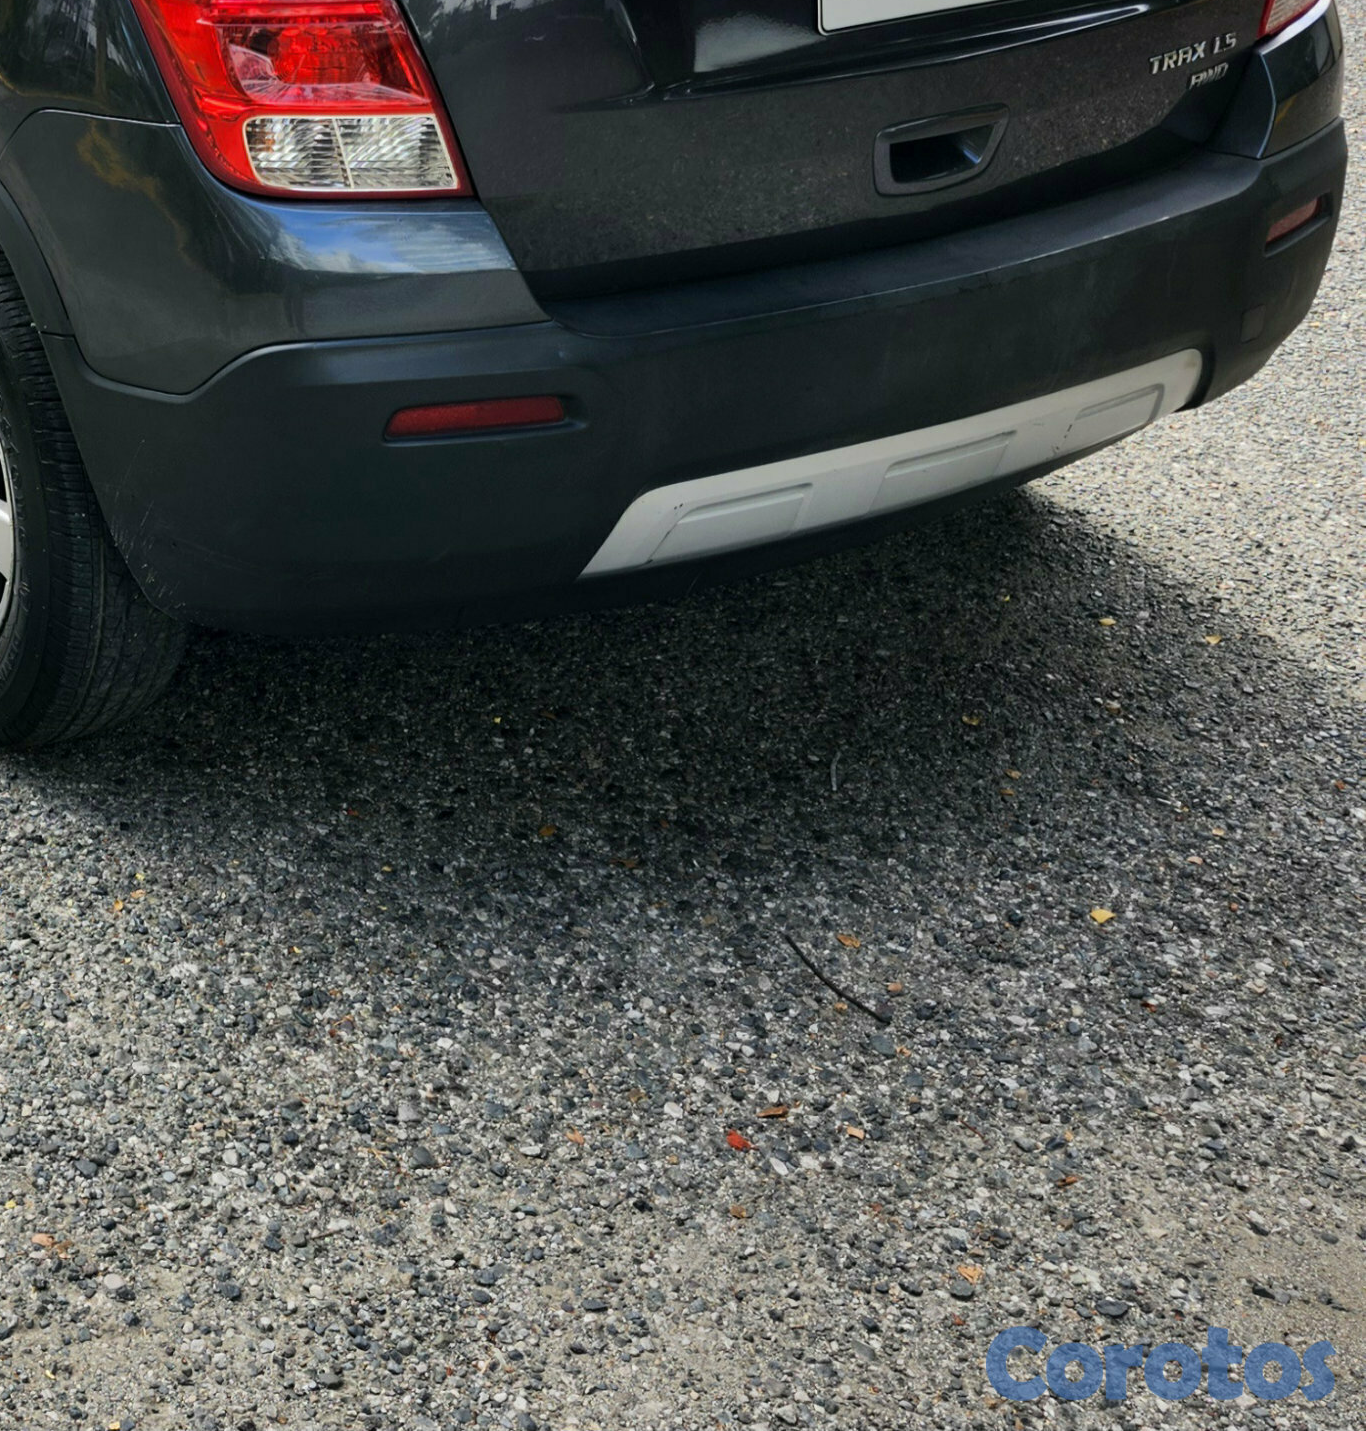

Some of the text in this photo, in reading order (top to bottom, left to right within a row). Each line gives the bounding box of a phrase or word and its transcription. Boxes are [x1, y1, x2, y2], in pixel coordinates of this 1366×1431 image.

[1149, 32, 1237, 75] TRAX LS
[1188, 62, 1229, 90] AWD
